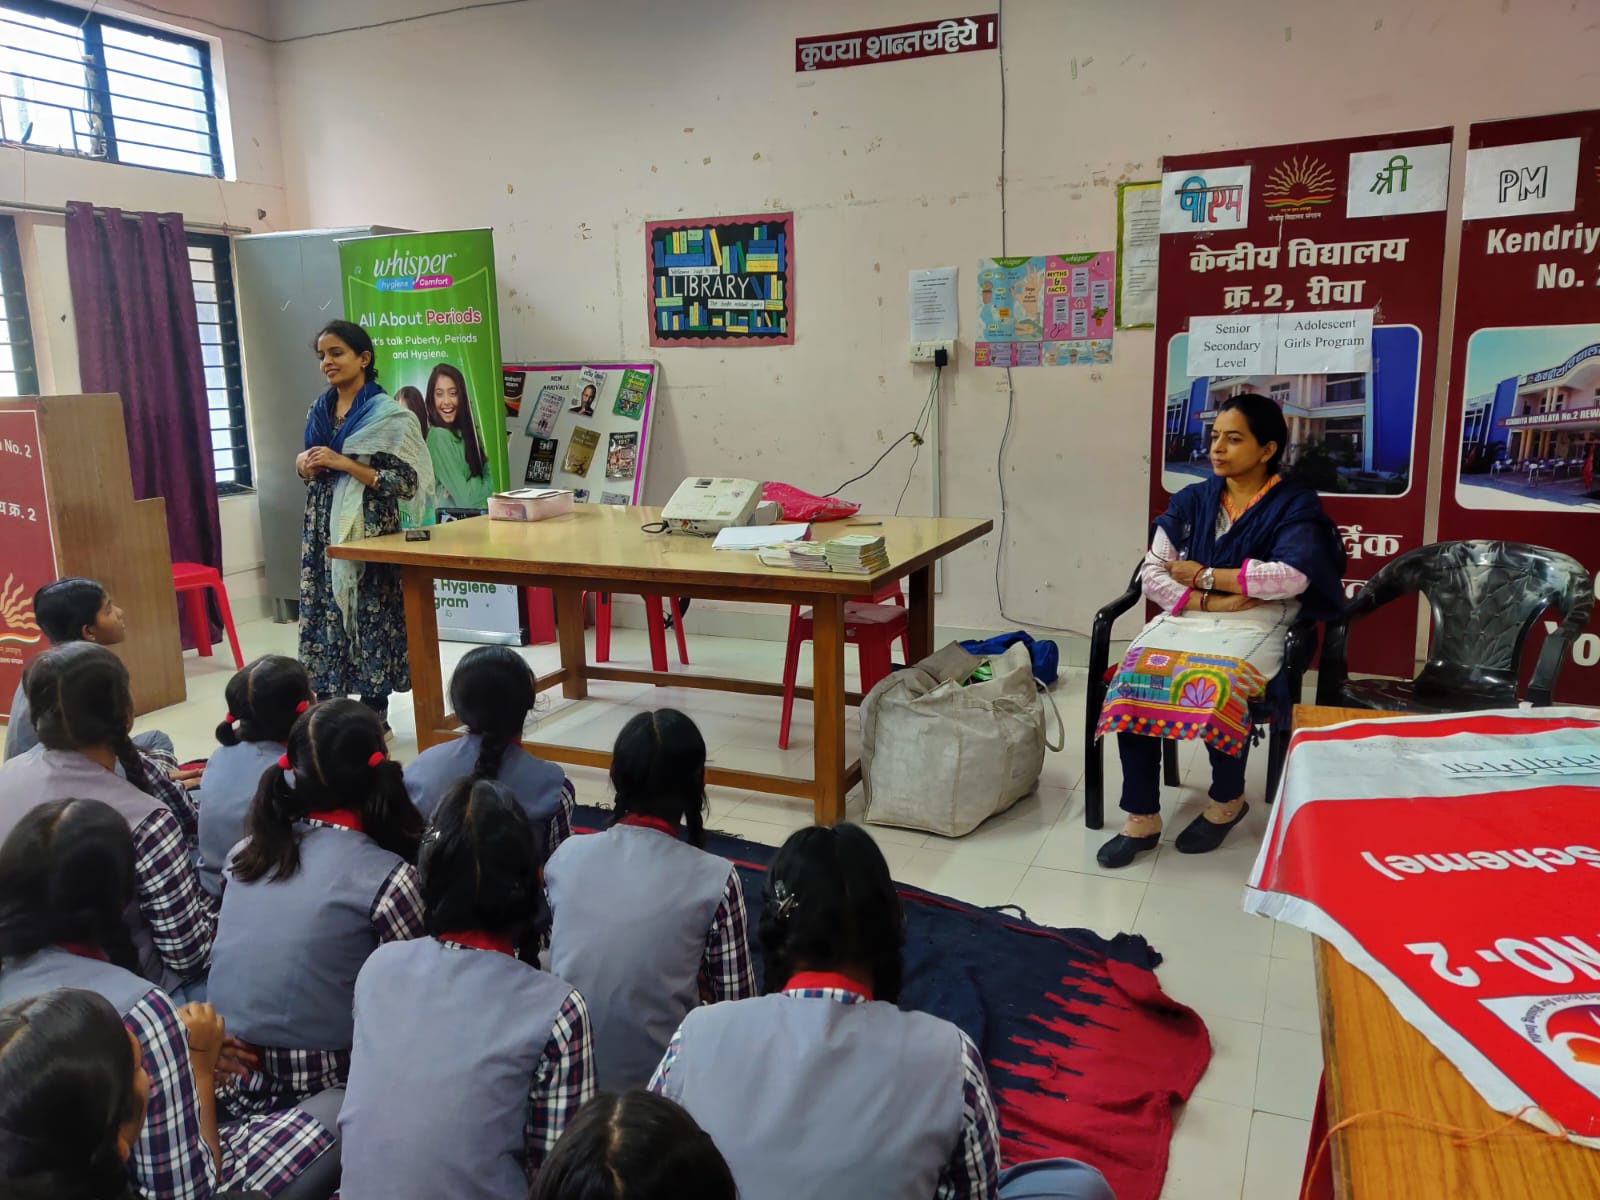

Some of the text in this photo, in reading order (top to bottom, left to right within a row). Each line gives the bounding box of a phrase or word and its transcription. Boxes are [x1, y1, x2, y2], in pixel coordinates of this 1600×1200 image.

[799, 38, 862, 70] कृपया
[866, 31, 922, 59] शान्त
[922, 18, 979, 53] रहिये
[1369, 154, 1413, 195] श्री
[1498, 165, 1548, 203] PM
[1487, 222, 1600, 255] Kendriy
[373, 248, 454, 282] whisper
[1189, 238, 1410, 273] केन्द्रीय विद्यालय
[1537, 262, 1585, 290] No.
[673, 274, 749, 299] LIBRARY
[1306, 276, 1366, 305] रीवा
[360, 306, 481, 328] All About Periods
[1294, 319, 1356, 331] Adolescent
[1215, 324, 1252, 334] Senior
[387, 337, 402, 346] talk
[405, 335, 442, 347] Puberty,
[444, 333, 478, 344] Periods
[1203, 340, 1261, 353] Secondary
[1284, 336, 1365, 349] Girls Program
[393, 349, 449, 361] and Hygiene.
[1216, 357, 1246, 369] Level
[4, 439, 32, 458] No. 2
[27, 507, 37, 521] 2
[441, 579, 497, 594] Hygiene
[434, 596, 468, 609] gram
[1404, 942, 1481, 988] 2
